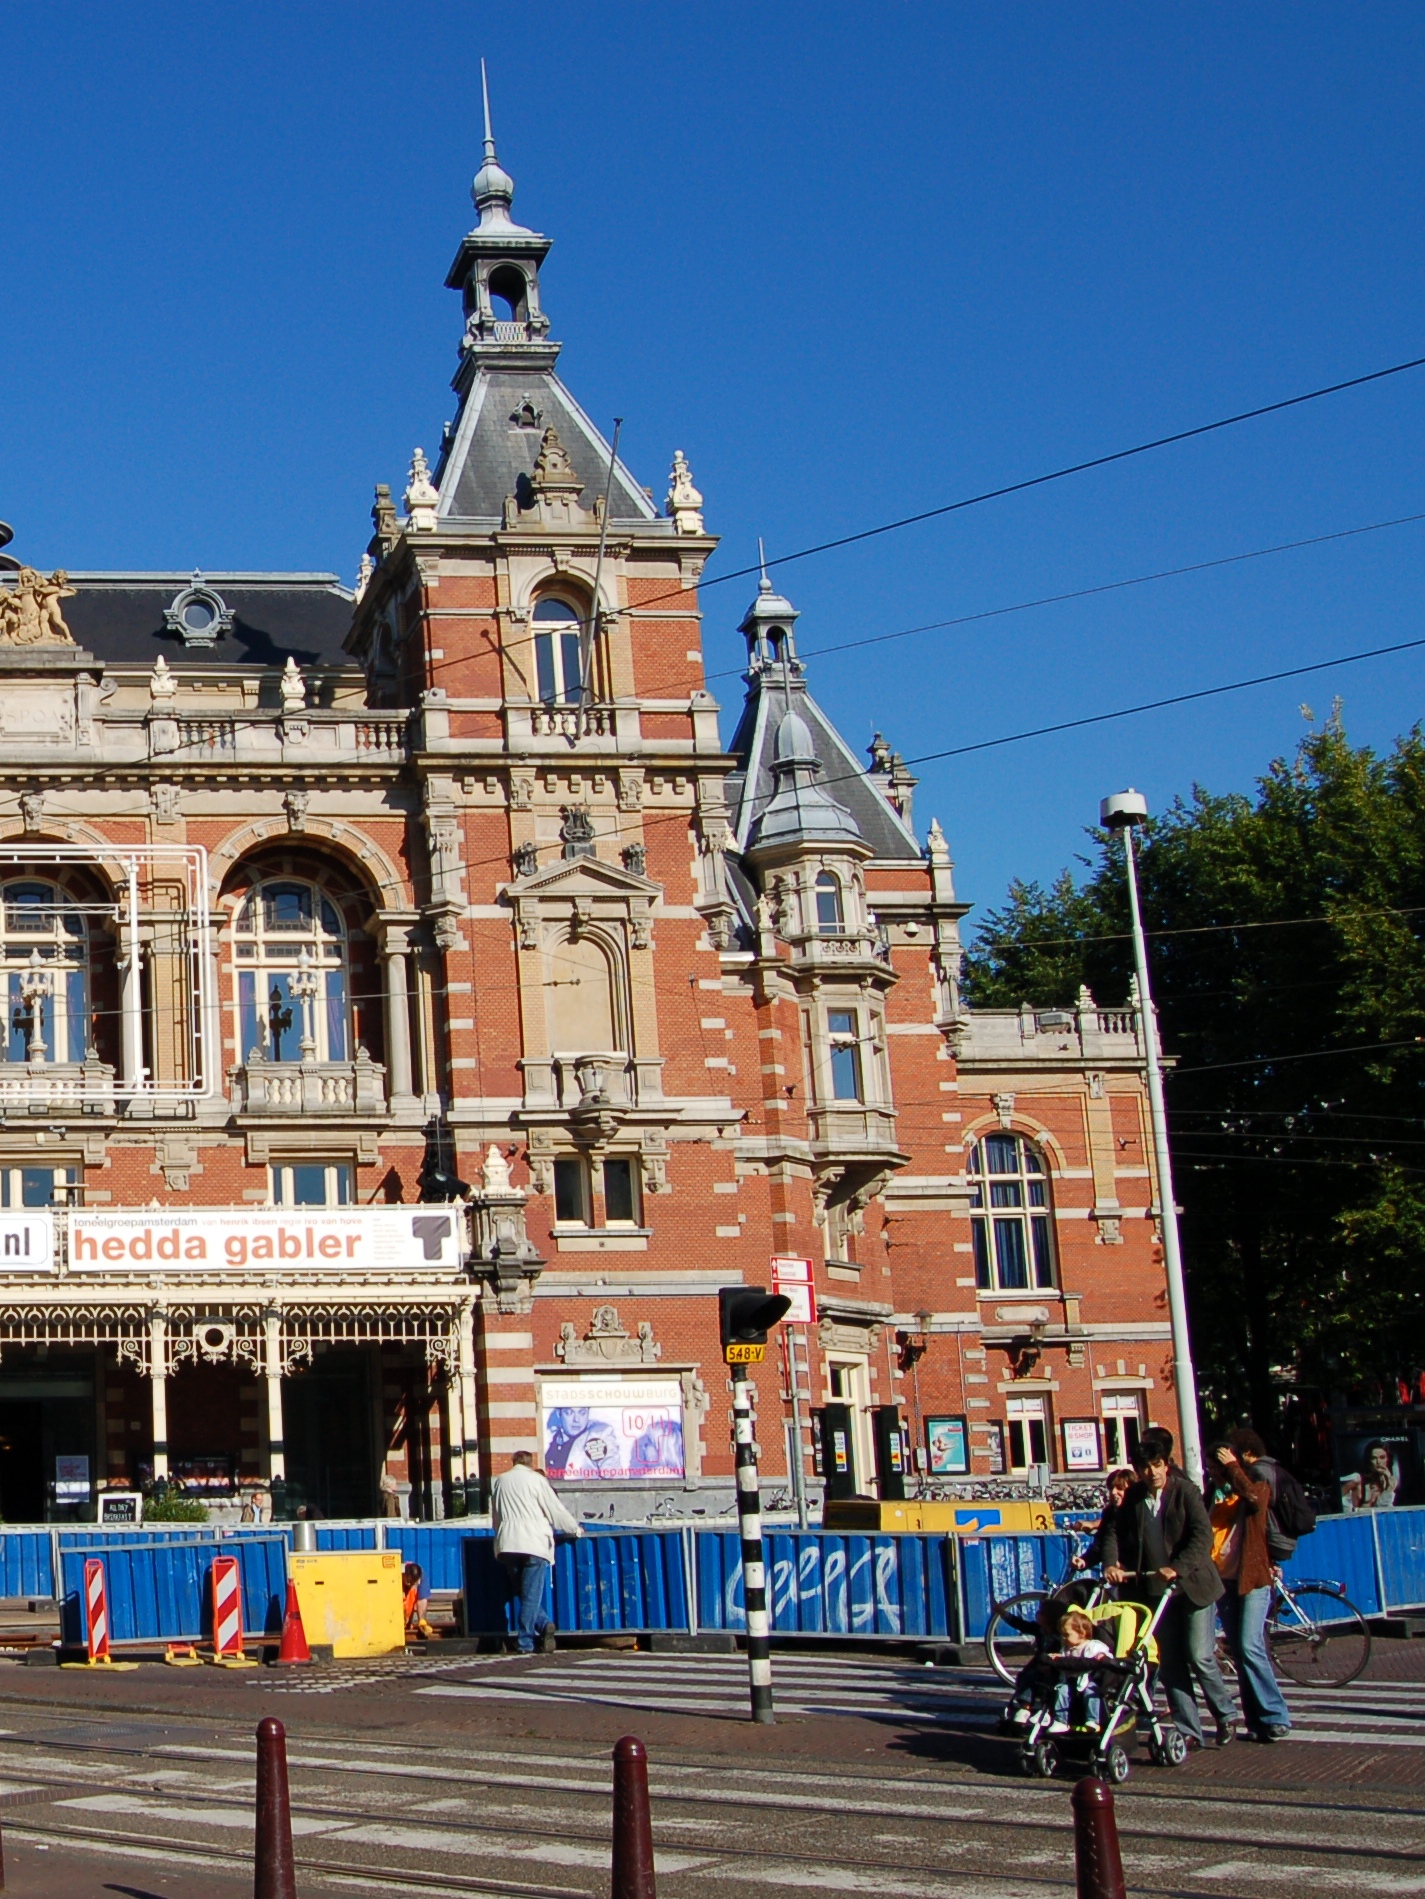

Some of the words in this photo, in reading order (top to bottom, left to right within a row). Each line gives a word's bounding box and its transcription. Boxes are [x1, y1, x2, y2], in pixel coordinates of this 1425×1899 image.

[74, 1217, 198, 1229] toneelgroepamsterdam
[202, 1219, 218, 1227] van
[220, 1218, 249, 1226] henrik
[252, 1218, 277, 1226] ibsen
[280, 1218, 302, 1228] regie
[340, 1217, 363, 1225] hove
[74, 1228, 208, 1261] hedda
[224, 1227, 362, 1267] gabler
[1068, 1424, 1093, 1432] TICKET
